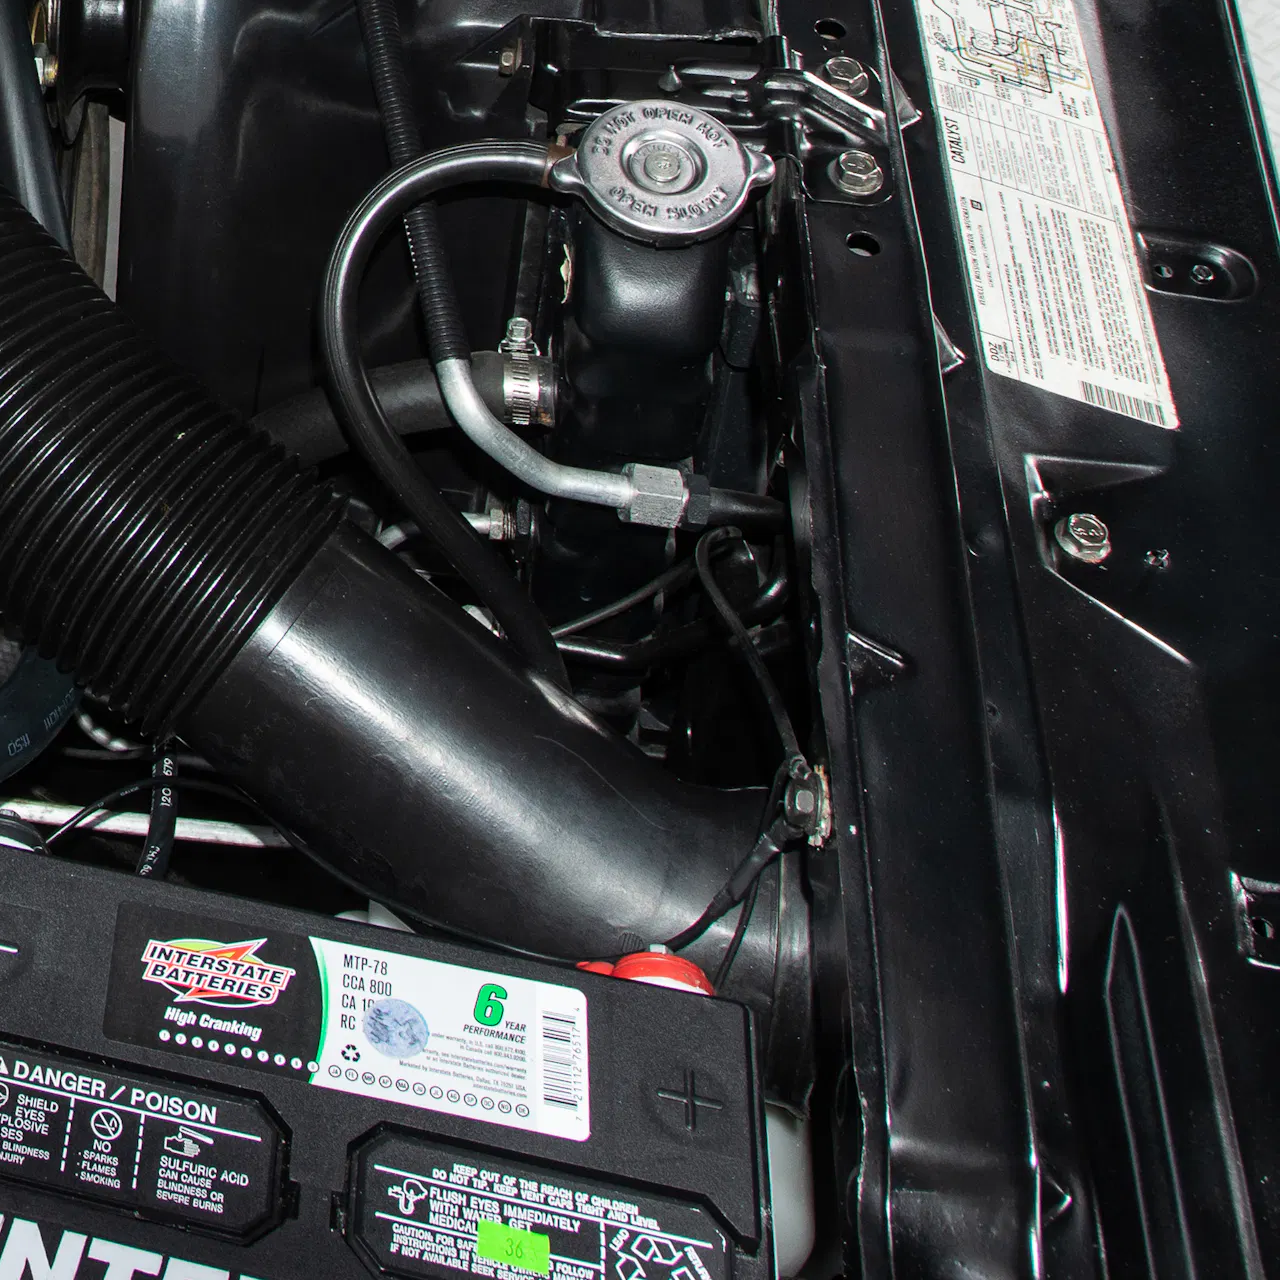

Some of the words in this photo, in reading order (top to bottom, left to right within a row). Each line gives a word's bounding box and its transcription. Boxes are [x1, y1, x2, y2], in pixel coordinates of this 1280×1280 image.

[604, 110, 636, 137] NOT
[643, 107, 692, 125] OPEN
[696, 122, 729, 148] HOT
[943, 115, 966, 164] CATALYST
[609, 186, 658, 217] OPEN
[666, 186, 728, 219] SLOWLY
[149, 945, 284, 985] INTERSTATE
[343, 954, 388, 976] MTP-78
[151, 963, 274, 999] BATTERIES
[342, 974, 365, 992] CCA
[369, 979, 392, 996] 800
[341, 994, 356, 1011] CA
[473, 983, 508, 1026] 6
[164, 1006, 197, 1027] High
[199, 1014, 262, 1042] Cranking
[341, 1014, 355, 1030] RC
[463, 1024, 527, 1044] PERFORMANCE
[505, 1020, 526, 1032] YEAR
[14, 1060, 106, 1098] DANGER
[130, 1087, 218, 1125] POISON
[17, 1093, 59, 1113] SHIELD
[15, 1107, 46, 1122] EYES
[2, 1140, 50, 1160] BLINDNESS
[82, 1149, 119, 1166] SPARKS
[93, 1139, 112, 1153] NO
[79, 1171, 121, 1189] SMOKING
[81, 1160, 117, 1177] FLAMES
[158, 1168, 178, 1181] CAN
[181, 1174, 212, 1188] CAUSE
[160, 1156, 218, 1178] SULFURIC
[221, 1170, 250, 1187] ACID
[157, 1179, 207, 1199] BLINDNESS
[209, 1192, 224, 1203] OR
[432, 1169, 446, 1181] DO
[449, 1172, 468, 1186] NOT
[470, 1177, 489, 1190] TIP.
[493, 1182, 519, 1197] KEEP
[520, 1188, 545, 1203] VENT
[548, 1193, 574, 1211] CAPS
[576, 1201, 606, 1218] TIGHT
[607, 1208, 629, 1222] AND
[630, 1212, 661, 1231] LEVEL
[453, 1163, 478, 1177] KEEP
[480, 1169, 500, 1183] OUT
[502, 1174, 516, 1186] OF
[518, 1177, 538, 1192] THE
[540, 1182, 573, 1200] REACH
[575, 1189, 589, 1203] OF
[590, 1193, 638, 1215] CHILDREN
[156, 1190, 190, 1205] SEVERE
[192, 1198, 224, 1214] BURNS
[429, 1186, 468, 1205] FLUSH
[470, 1195, 500, 1214] EYES
[503, 1202, 581, 1233] IMMEDIATELY
[429, 1199, 460, 1216] WITH
[462, 1207, 502, 1225] WATER
[428, 1213, 479, 1234] MEDICAL
[392, 1233, 458, 1254] INSTRUCTIONS
[460, 1248, 470, 1259] IN
[609, 1229, 630, 1252] LEAD
[390, 1242, 399, 1253] IF
[401, 1244, 421, 1259] NOT
[422, 1249, 469, 1270] AVAILABLE
[471, 1260, 494, 1275] SEEK
[435, 1230, 454, 1245] FOR
[556, 1260, 594, 1279] FOLLOW
